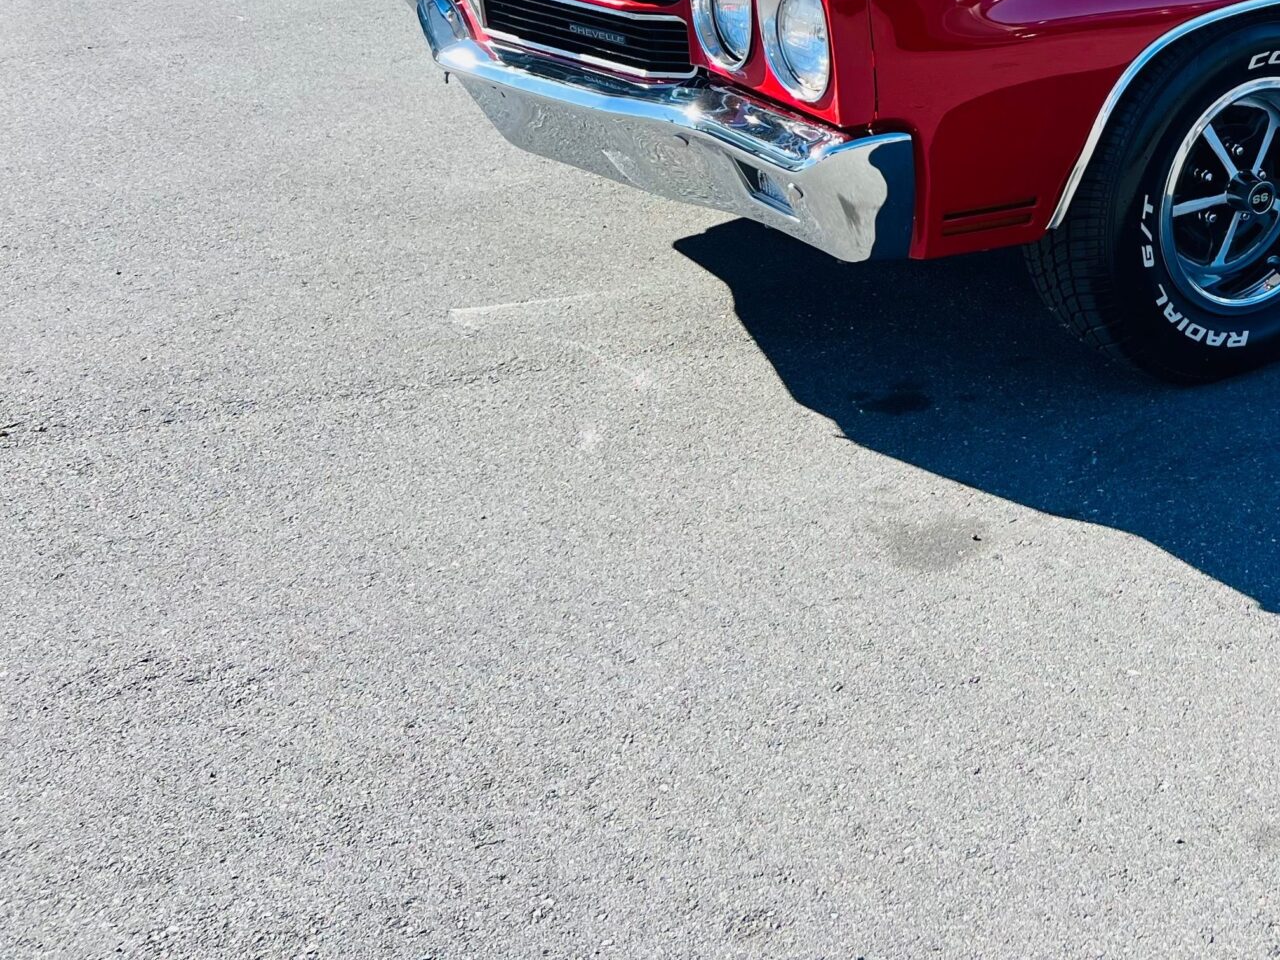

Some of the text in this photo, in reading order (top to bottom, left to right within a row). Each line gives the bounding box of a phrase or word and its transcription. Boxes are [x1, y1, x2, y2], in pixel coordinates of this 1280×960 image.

[569, 24, 625, 44] CHEVELLE
[1140, 194, 1250, 348] RADIAL G/T
